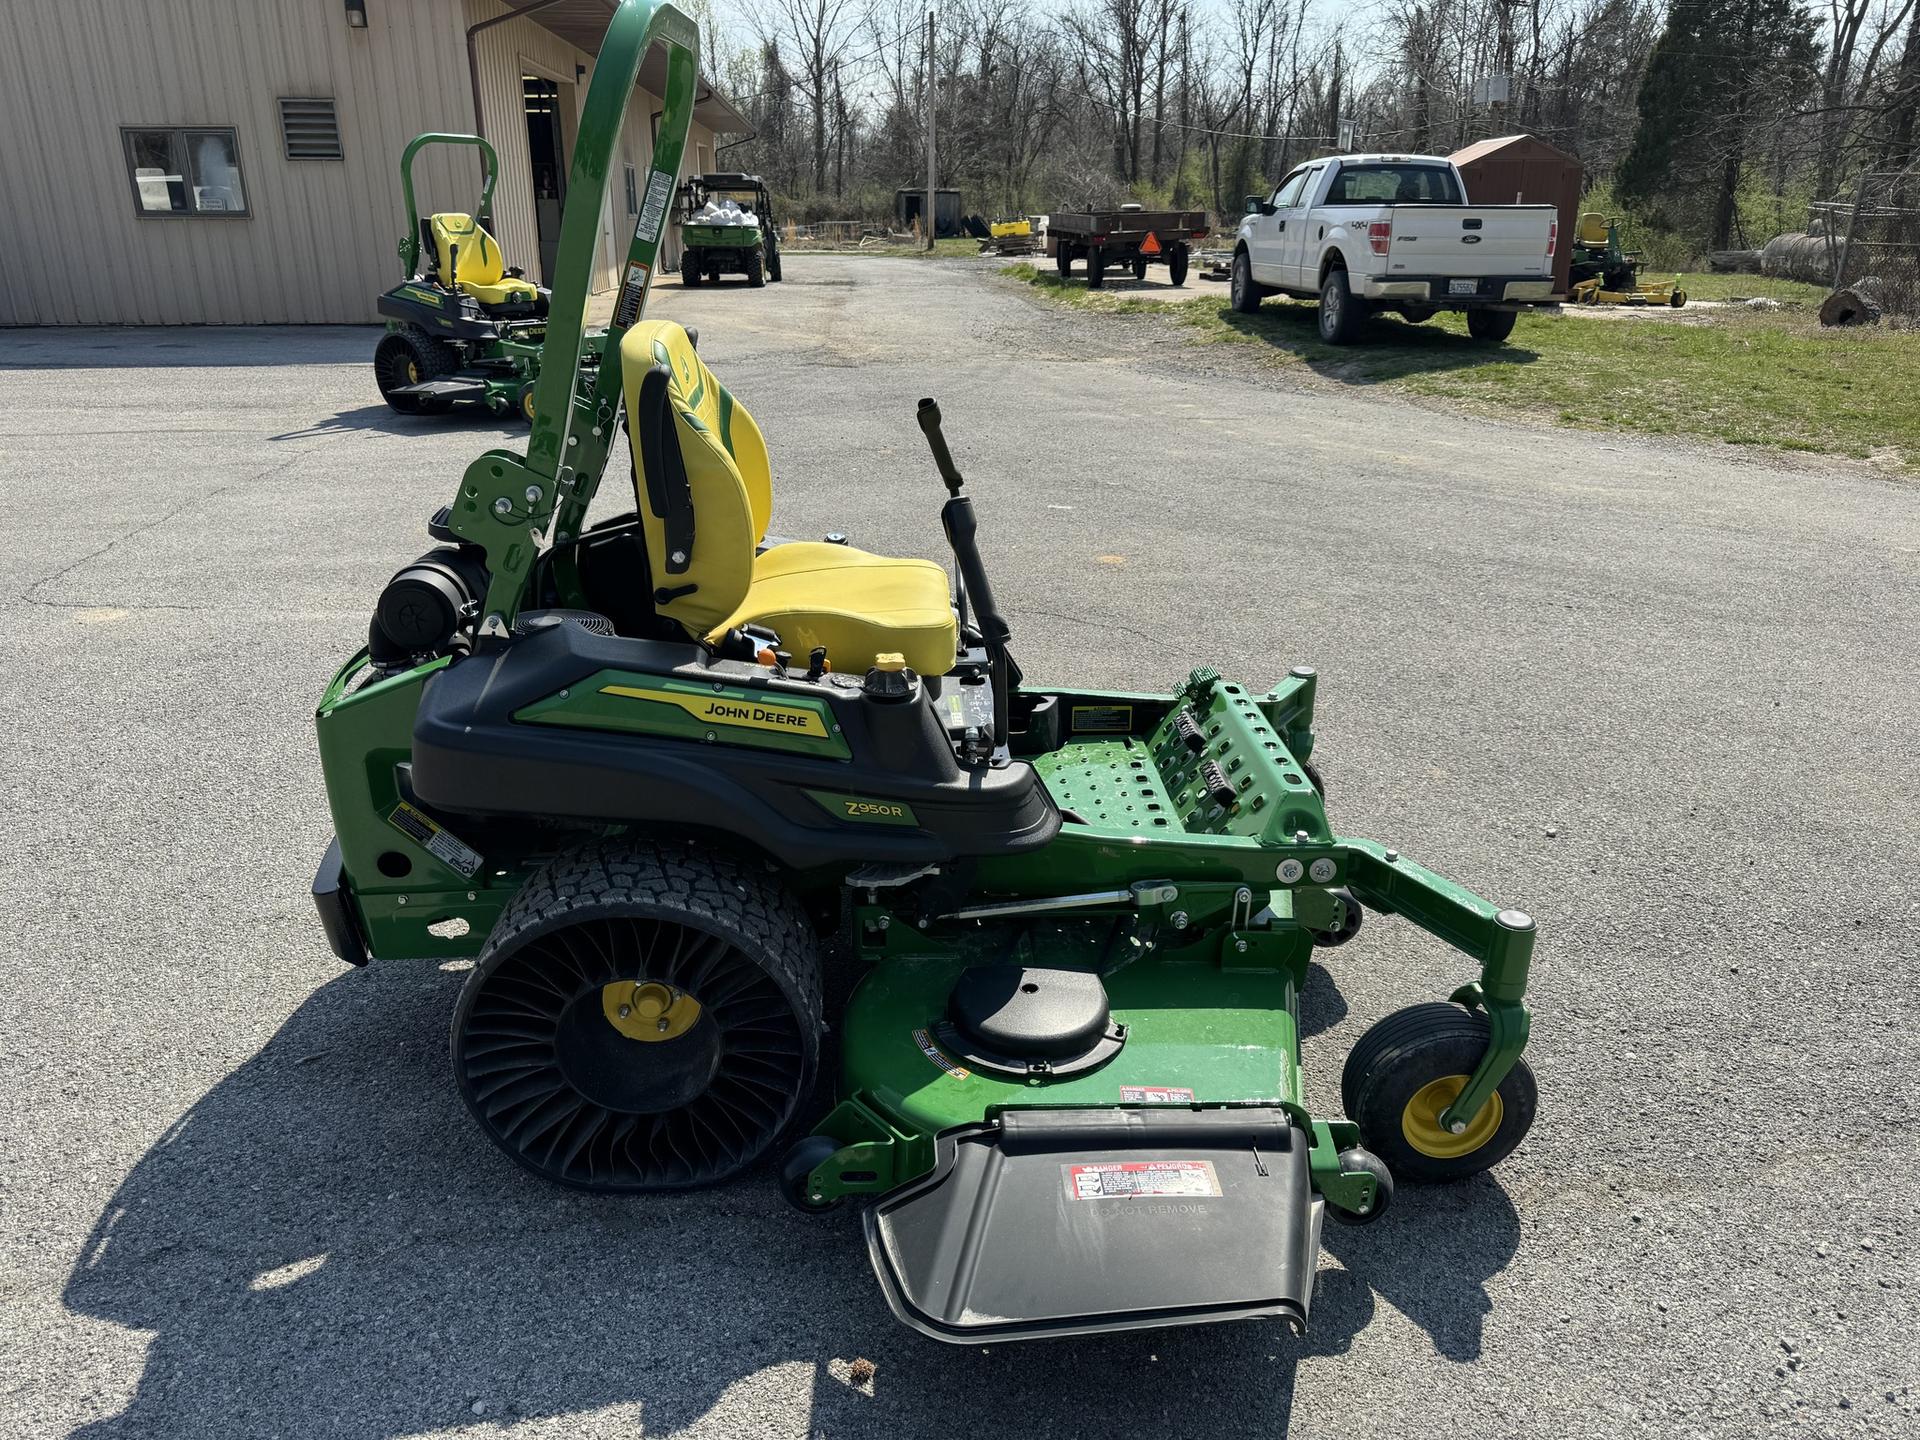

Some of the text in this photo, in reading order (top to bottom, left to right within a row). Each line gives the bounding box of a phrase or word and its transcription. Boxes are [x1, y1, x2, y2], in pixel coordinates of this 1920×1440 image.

[528, 327, 547, 335] DEER
[704, 702, 808, 727] JOHN DEERE
[844, 801, 903, 817] Z950R
[1093, 1164, 1123, 1172] DANGER
[1090, 1204, 1208, 1217] DO NOT REMOVE
